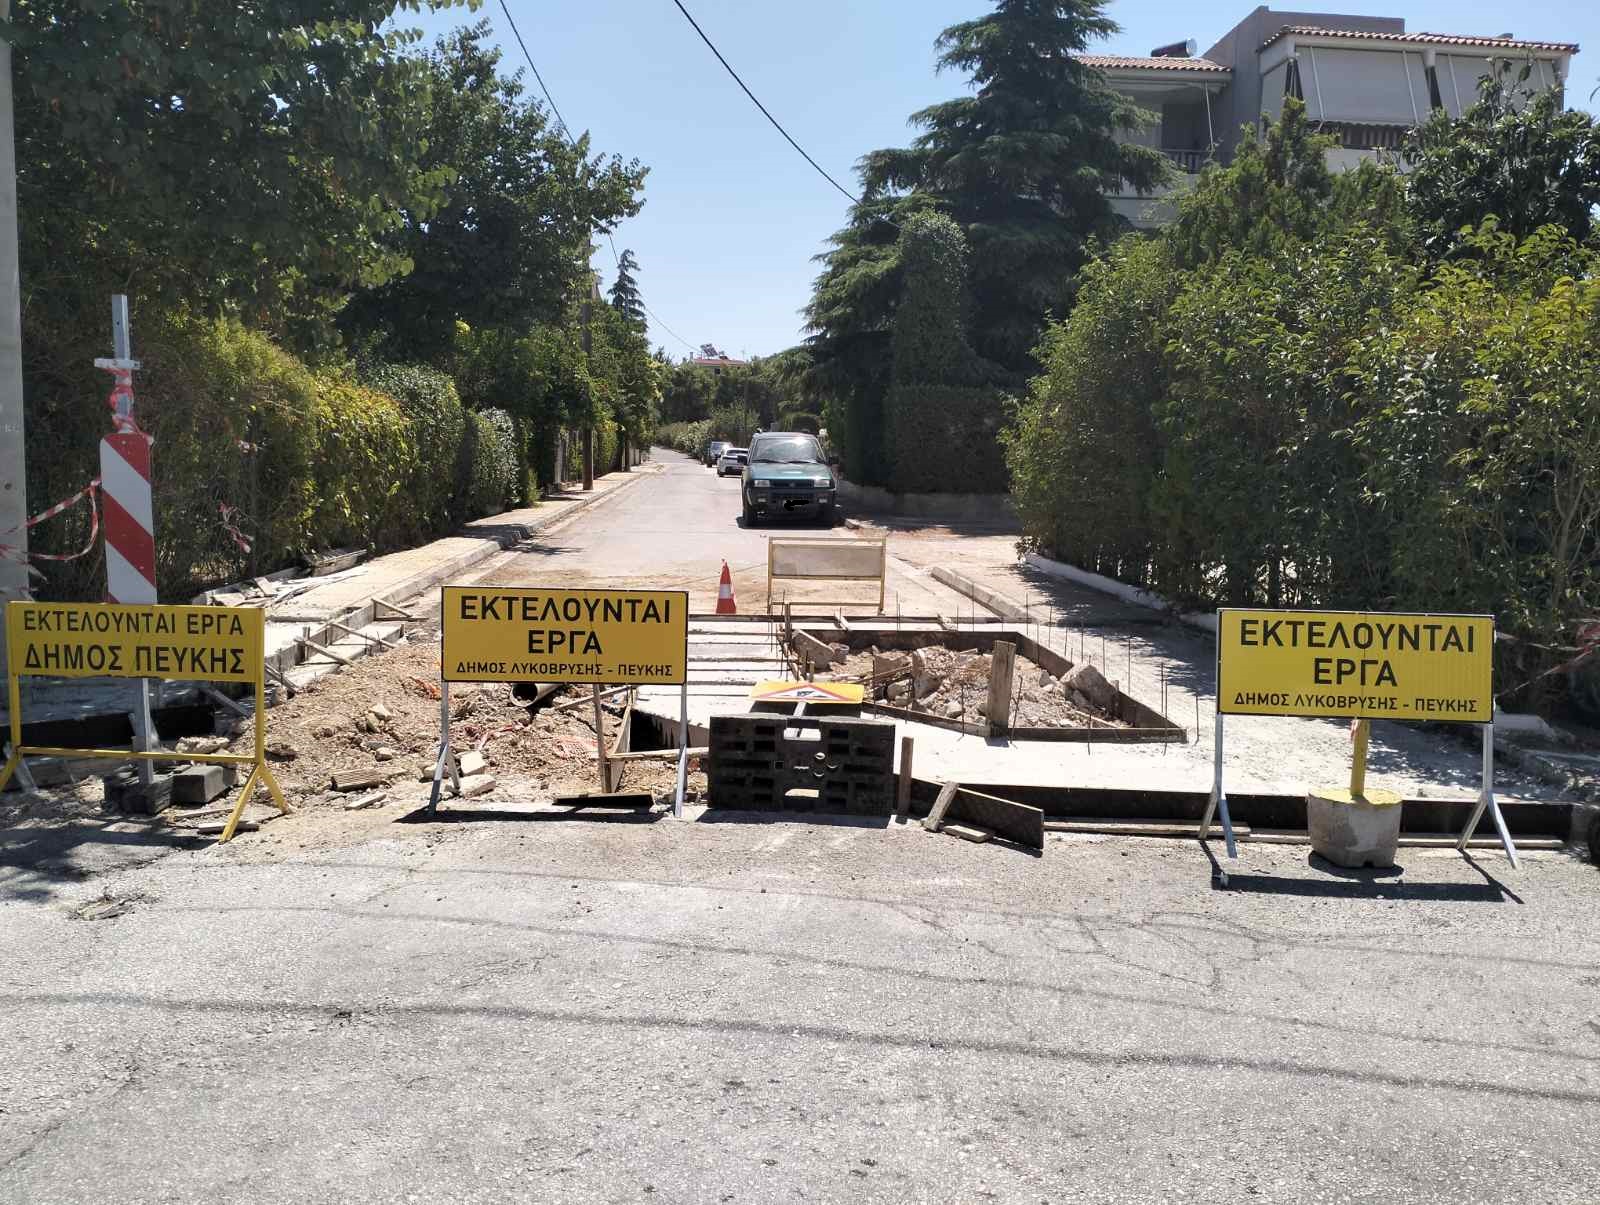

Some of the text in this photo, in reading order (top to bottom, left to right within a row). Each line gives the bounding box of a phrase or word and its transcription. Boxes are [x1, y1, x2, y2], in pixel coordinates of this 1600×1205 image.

[24, 609, 244, 635] ΕΚΤΕΛΟΥΝΤΑΙ ΕΡΓΑ
[460, 595, 670, 624] ΕΚΤΕΛΟΥΝΤΑΙ
[528, 630, 602, 655] ΕΡΓΑ
[1240, 619, 1474, 653] ΕΚΤΕΛΟΥΝΤΑΙ
[24, 643, 245, 674] ΔΗΜΟΣ ΠΕΥΚΗΣ
[456, 662, 506, 674] ΔΗΜΟΣ
[511, 663, 603, 676] ΛΥΚΟΒΡΥΣΗΣ
[618, 664, 673, 677] ΠΕΥΚΗΣ
[1313, 657, 1398, 687] ΕΡΓΑ
[1234, 692, 1290, 706] ΔΗΜΟΣ
[1294, 694, 1398, 710] ΛΥΚΟΒΡΥΣΗΣ
[1415, 698, 1477, 713] ΠΕΥΚΗΣ
